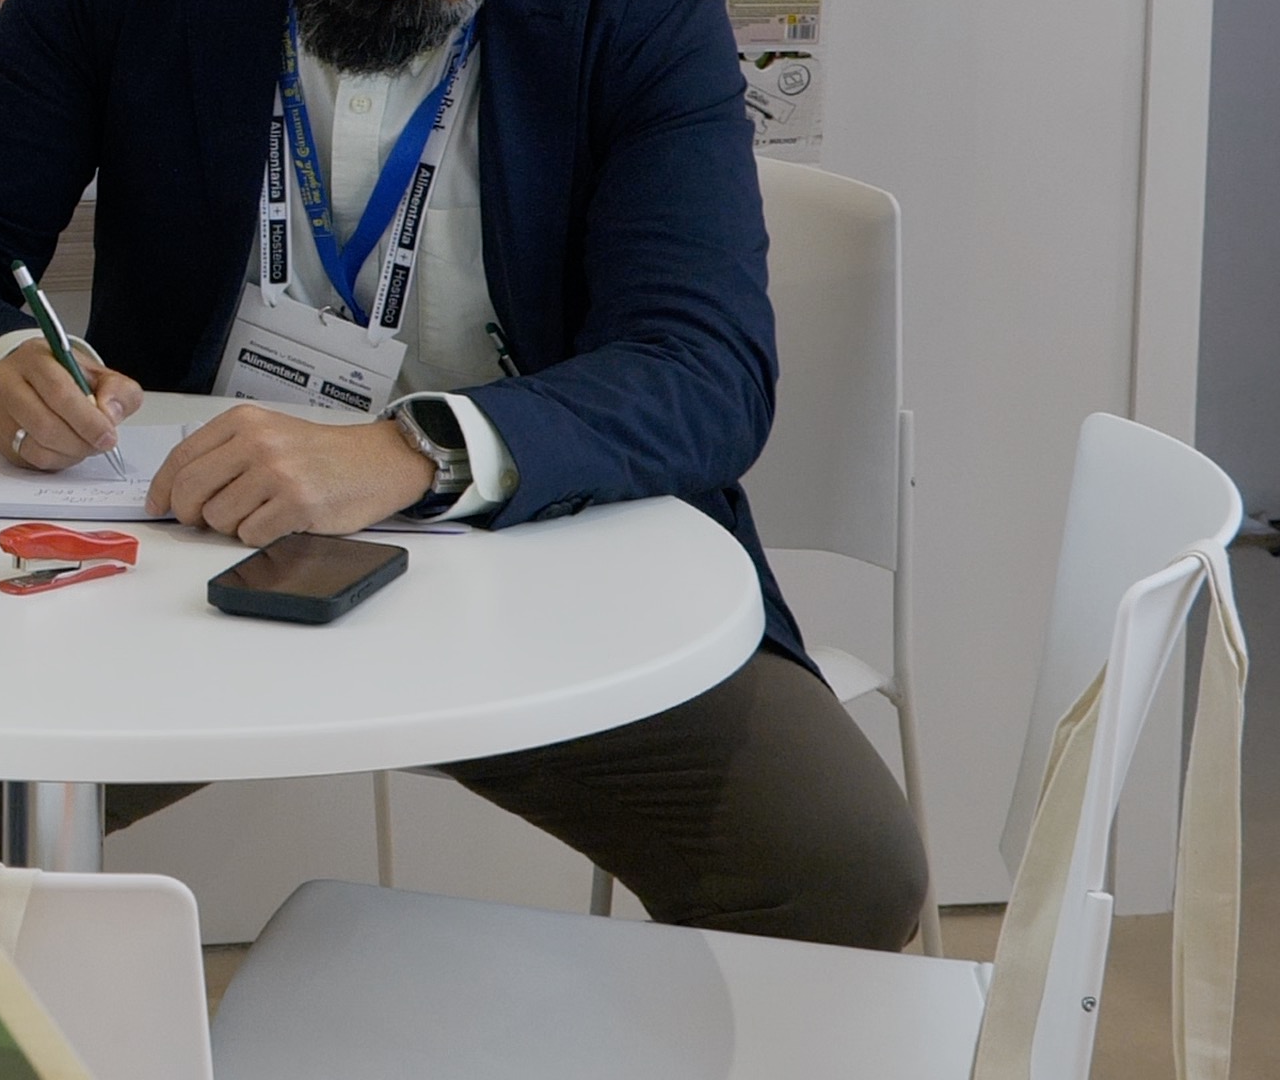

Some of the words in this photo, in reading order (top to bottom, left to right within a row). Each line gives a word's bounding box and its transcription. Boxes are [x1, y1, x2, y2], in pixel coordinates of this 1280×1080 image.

[270, 121, 282, 199] Alimentaria
[401, 168, 432, 245] Alimentaria
[272, 223, 283, 280] Hostelco
[382, 267, 407, 325] Hostelco
[241, 351, 307, 385] Alimentaria
[324, 383, 371, 410] Hostelco
